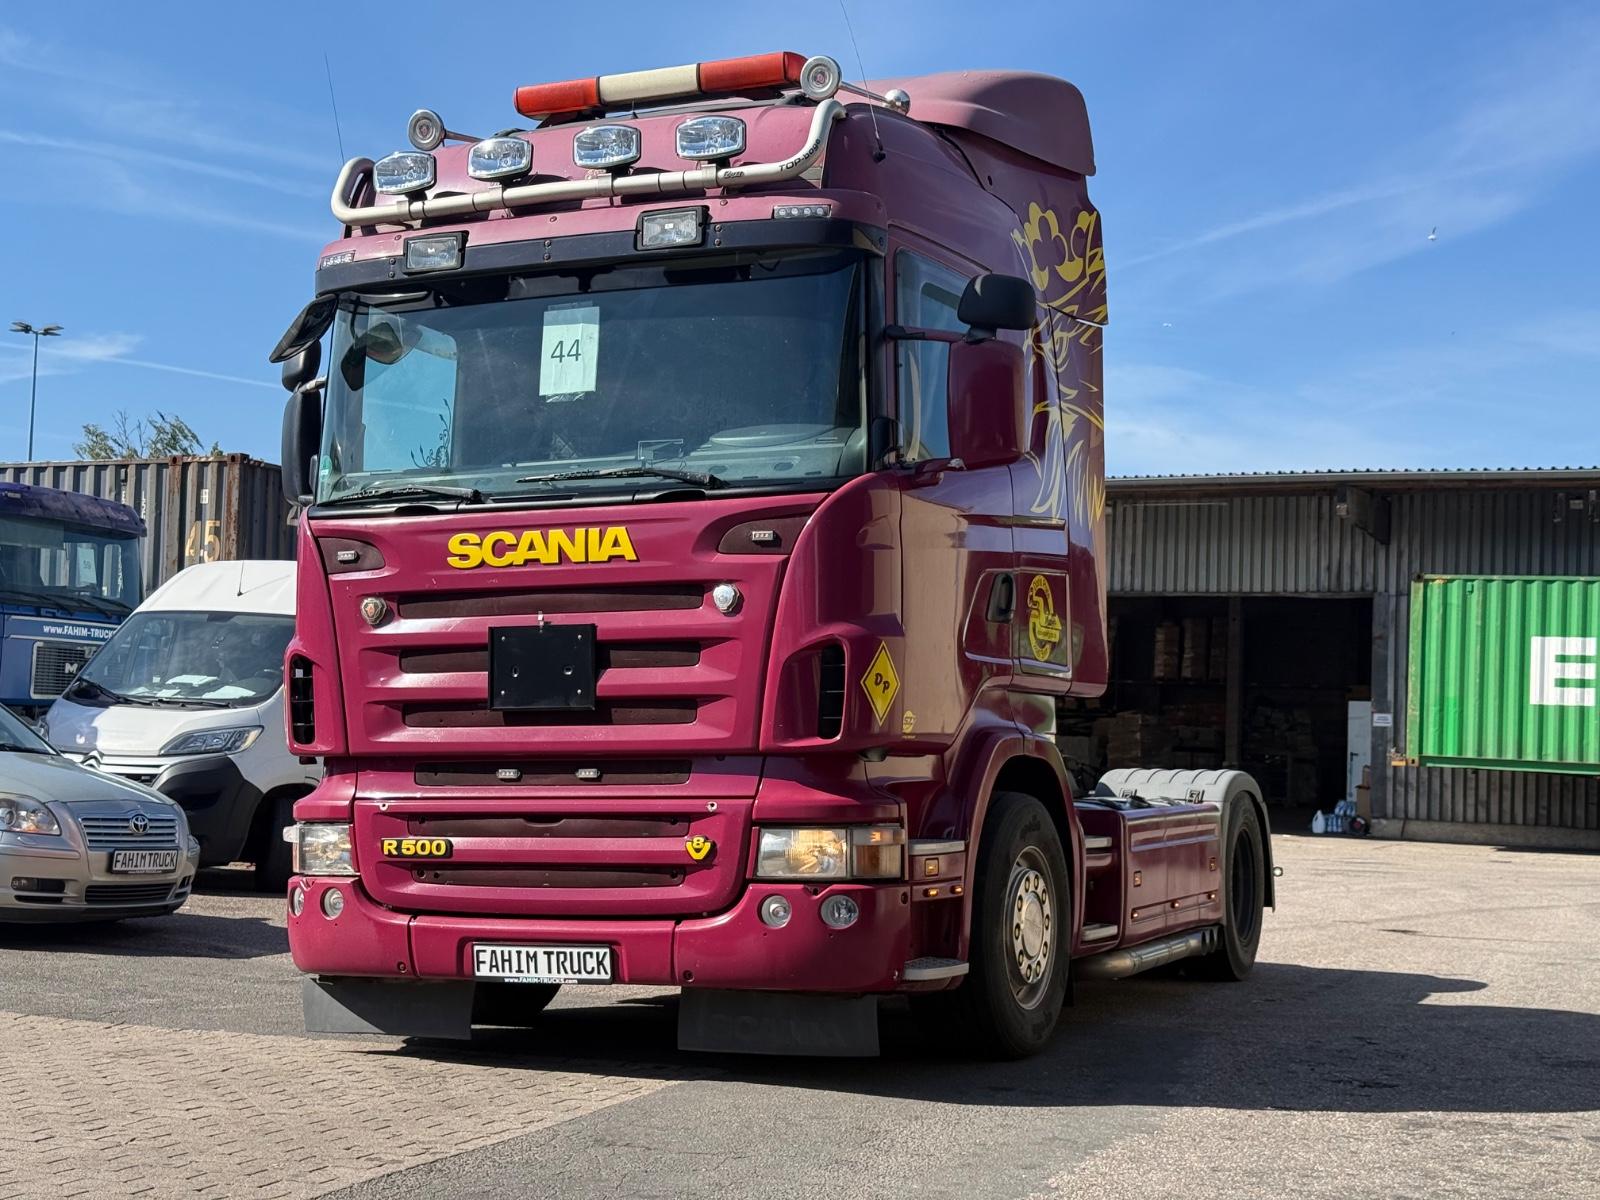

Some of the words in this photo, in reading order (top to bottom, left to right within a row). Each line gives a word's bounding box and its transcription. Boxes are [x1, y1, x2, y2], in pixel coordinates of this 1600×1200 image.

[550, 338, 582, 363] 44
[185, 520, 221, 563] 45
[447, 526, 640, 569] SCANIA
[43, 625, 114, 639] www.FAHIM-TRUCK
[1529, 635, 1597, 707] E
[115, 852, 147, 868] FAHIM
[148, 852, 176, 867] TRUCK
[383, 839, 398, 855] R
[401, 839, 446, 856] 500
[475, 949, 539, 974] FAHIM
[543, 950, 609, 975] TRUCK
